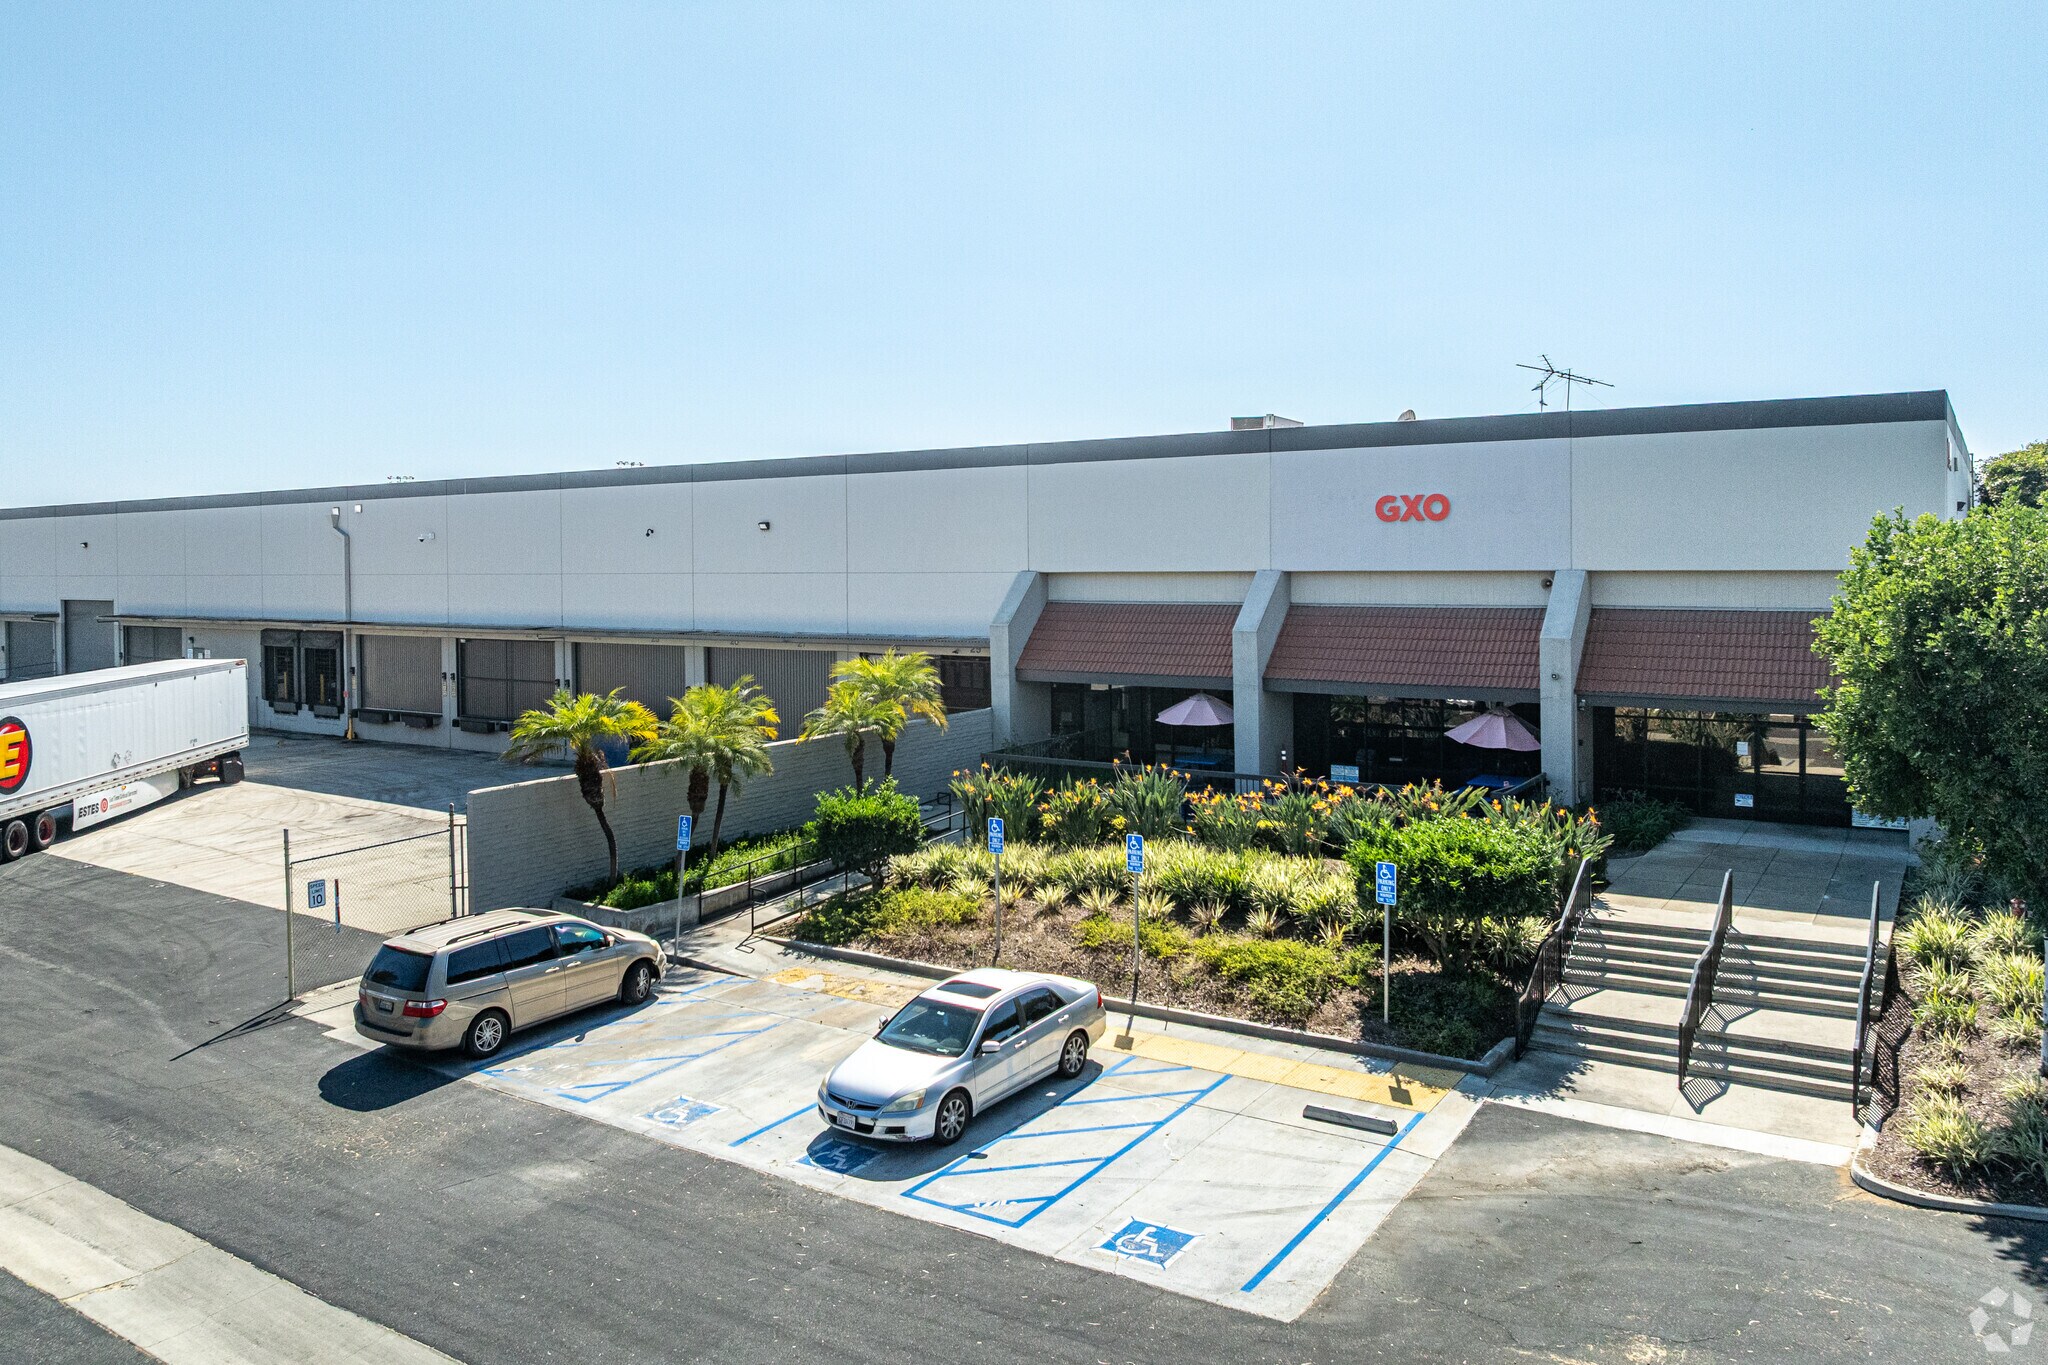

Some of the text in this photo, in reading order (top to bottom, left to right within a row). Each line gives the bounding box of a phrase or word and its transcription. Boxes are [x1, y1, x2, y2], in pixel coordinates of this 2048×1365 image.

[1375, 493, 1450, 522] GXO
[78, 803, 99, 819] ESTES
[312, 894, 323, 905] 10
